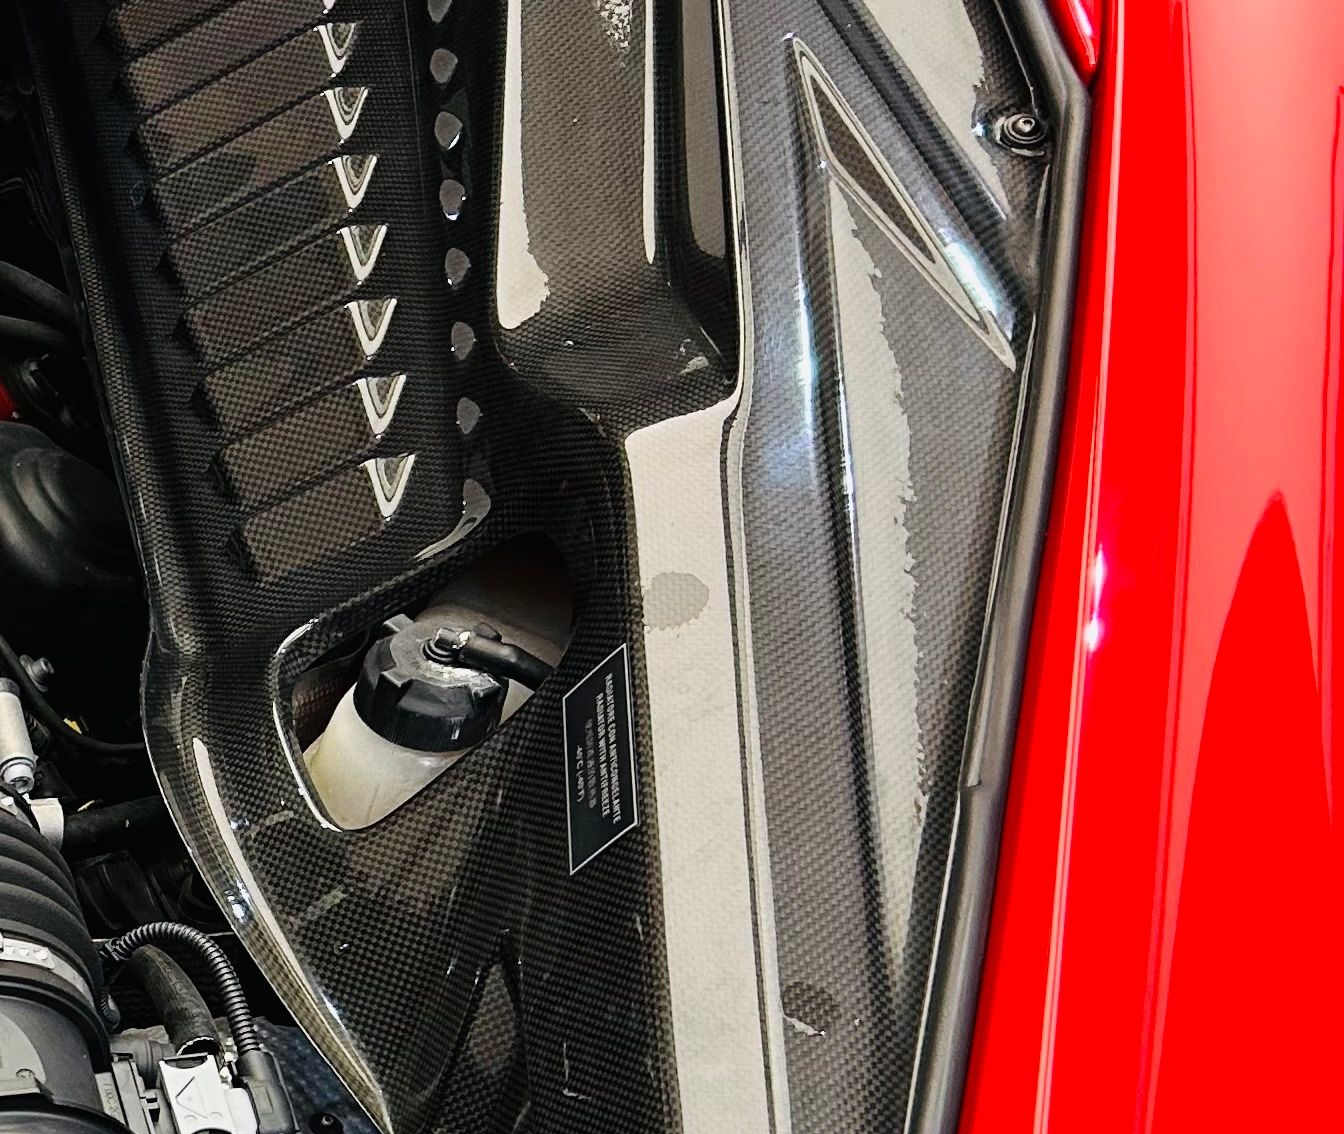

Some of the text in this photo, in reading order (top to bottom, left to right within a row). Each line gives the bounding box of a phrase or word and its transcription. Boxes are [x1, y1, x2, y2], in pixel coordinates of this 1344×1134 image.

[596, 693, 605, 738] RADIATOR
[608, 723, 616, 744] CON
[598, 737, 606, 762] WITH
